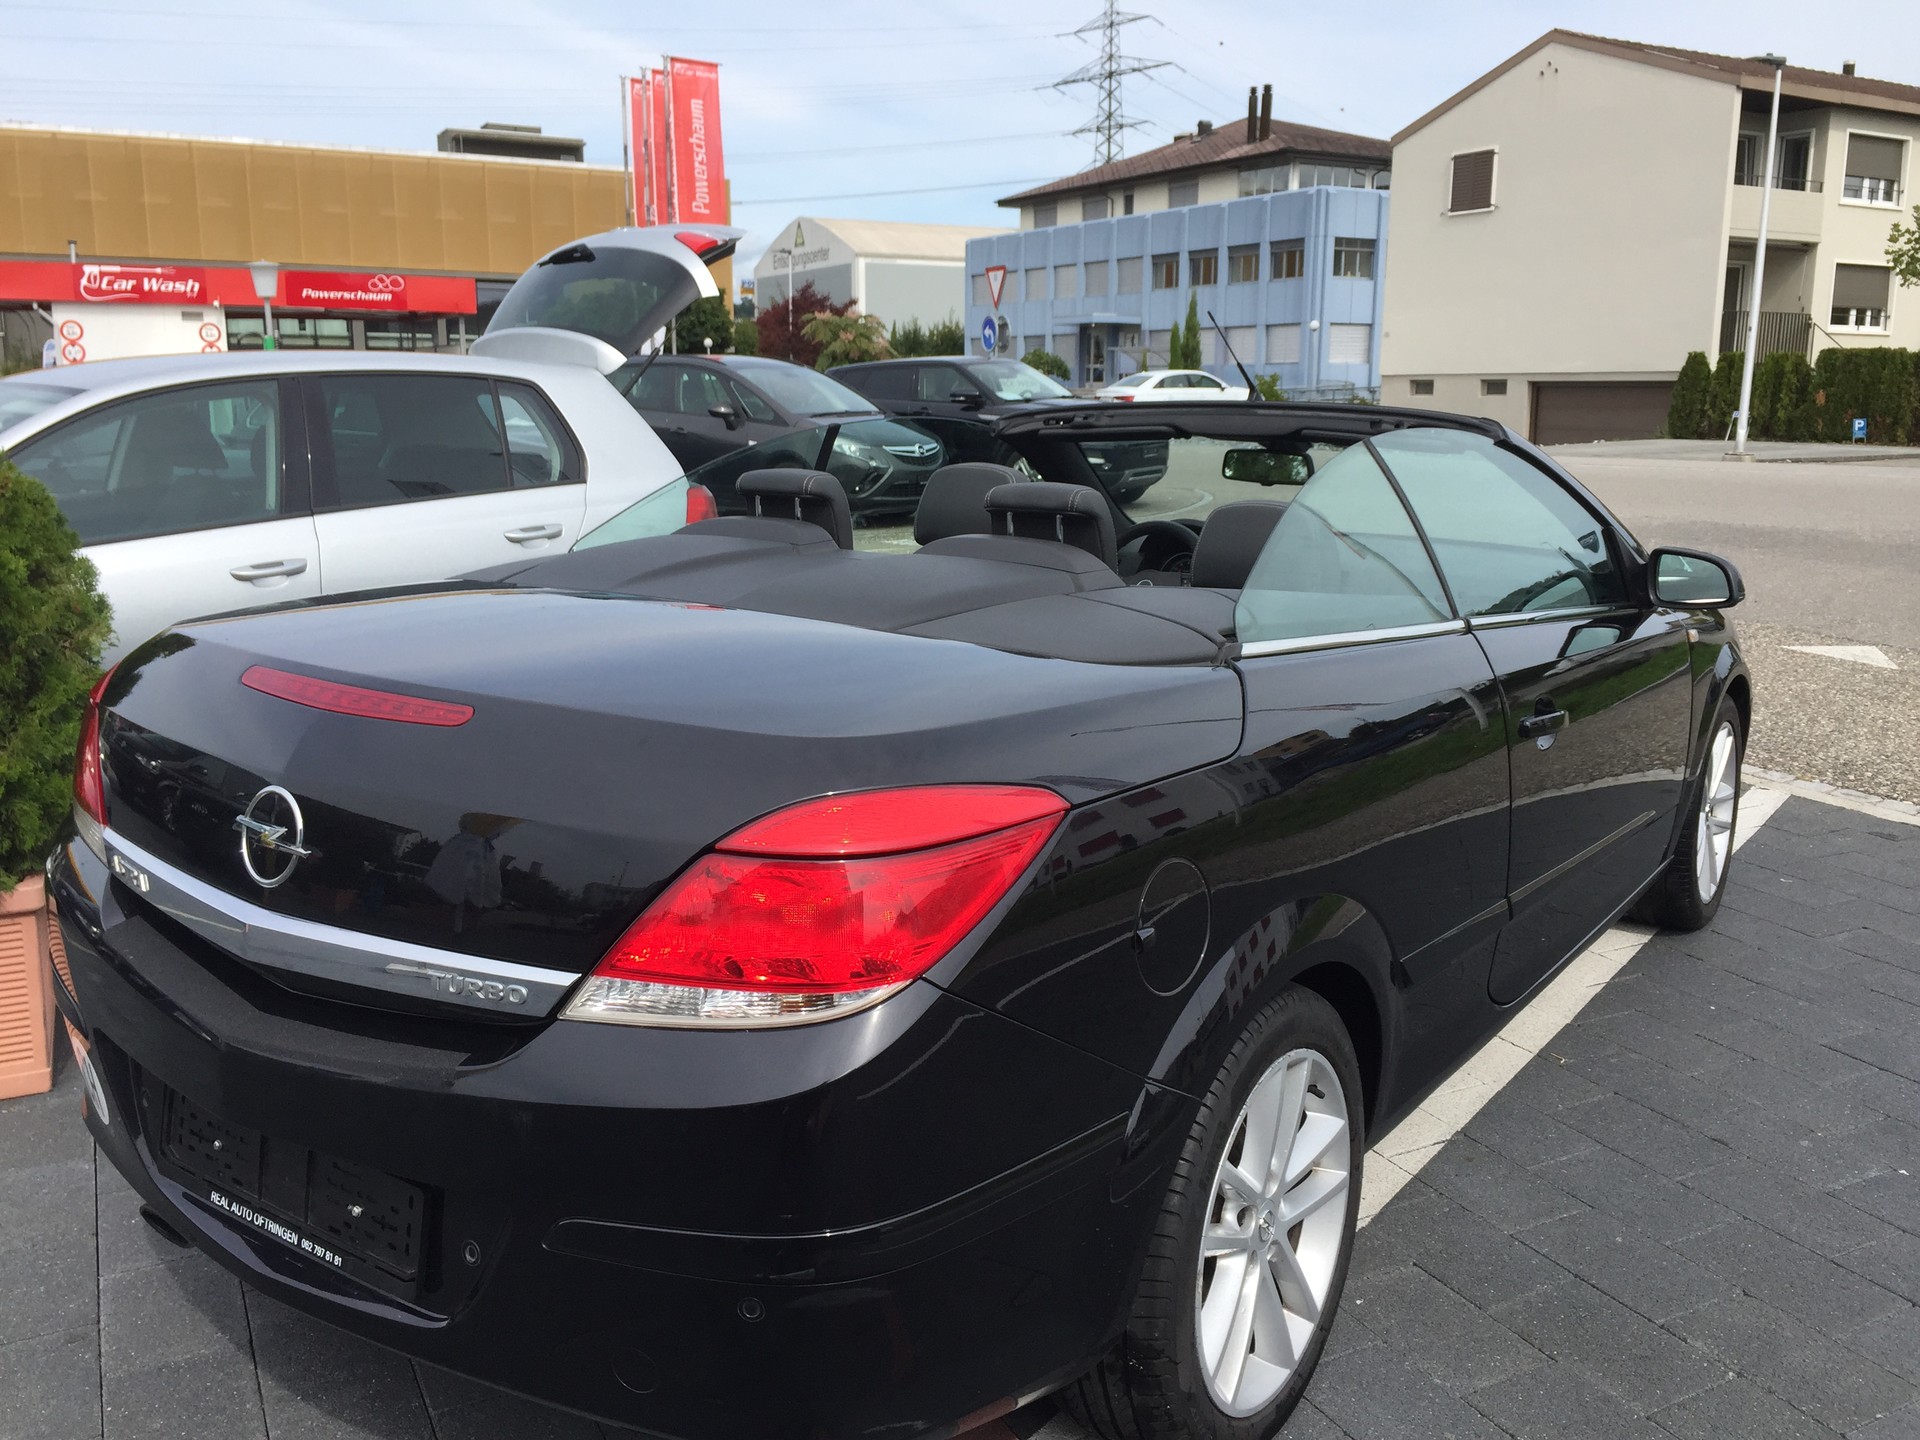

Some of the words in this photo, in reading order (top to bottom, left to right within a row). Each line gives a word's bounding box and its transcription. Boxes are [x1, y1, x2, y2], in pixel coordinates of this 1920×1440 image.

[689, 99, 710, 215] Powerschaum
[101, 275, 137, 291] Car
[143, 276, 200, 297] Wash
[302, 287, 393, 302] Powerschaum
[1855, 420, 1865, 431] P
[428, 969, 529, 1005] TURBO
[210, 1190, 230, 1210] REAL
[230, 1202, 253, 1221] AUTO
[253, 1212, 299, 1246] OFTRINGEN
[301, 1238, 313, 1252] 062
[313, 1244, 326, 1258] 797
[333, 1255, 342, 1267] 81
